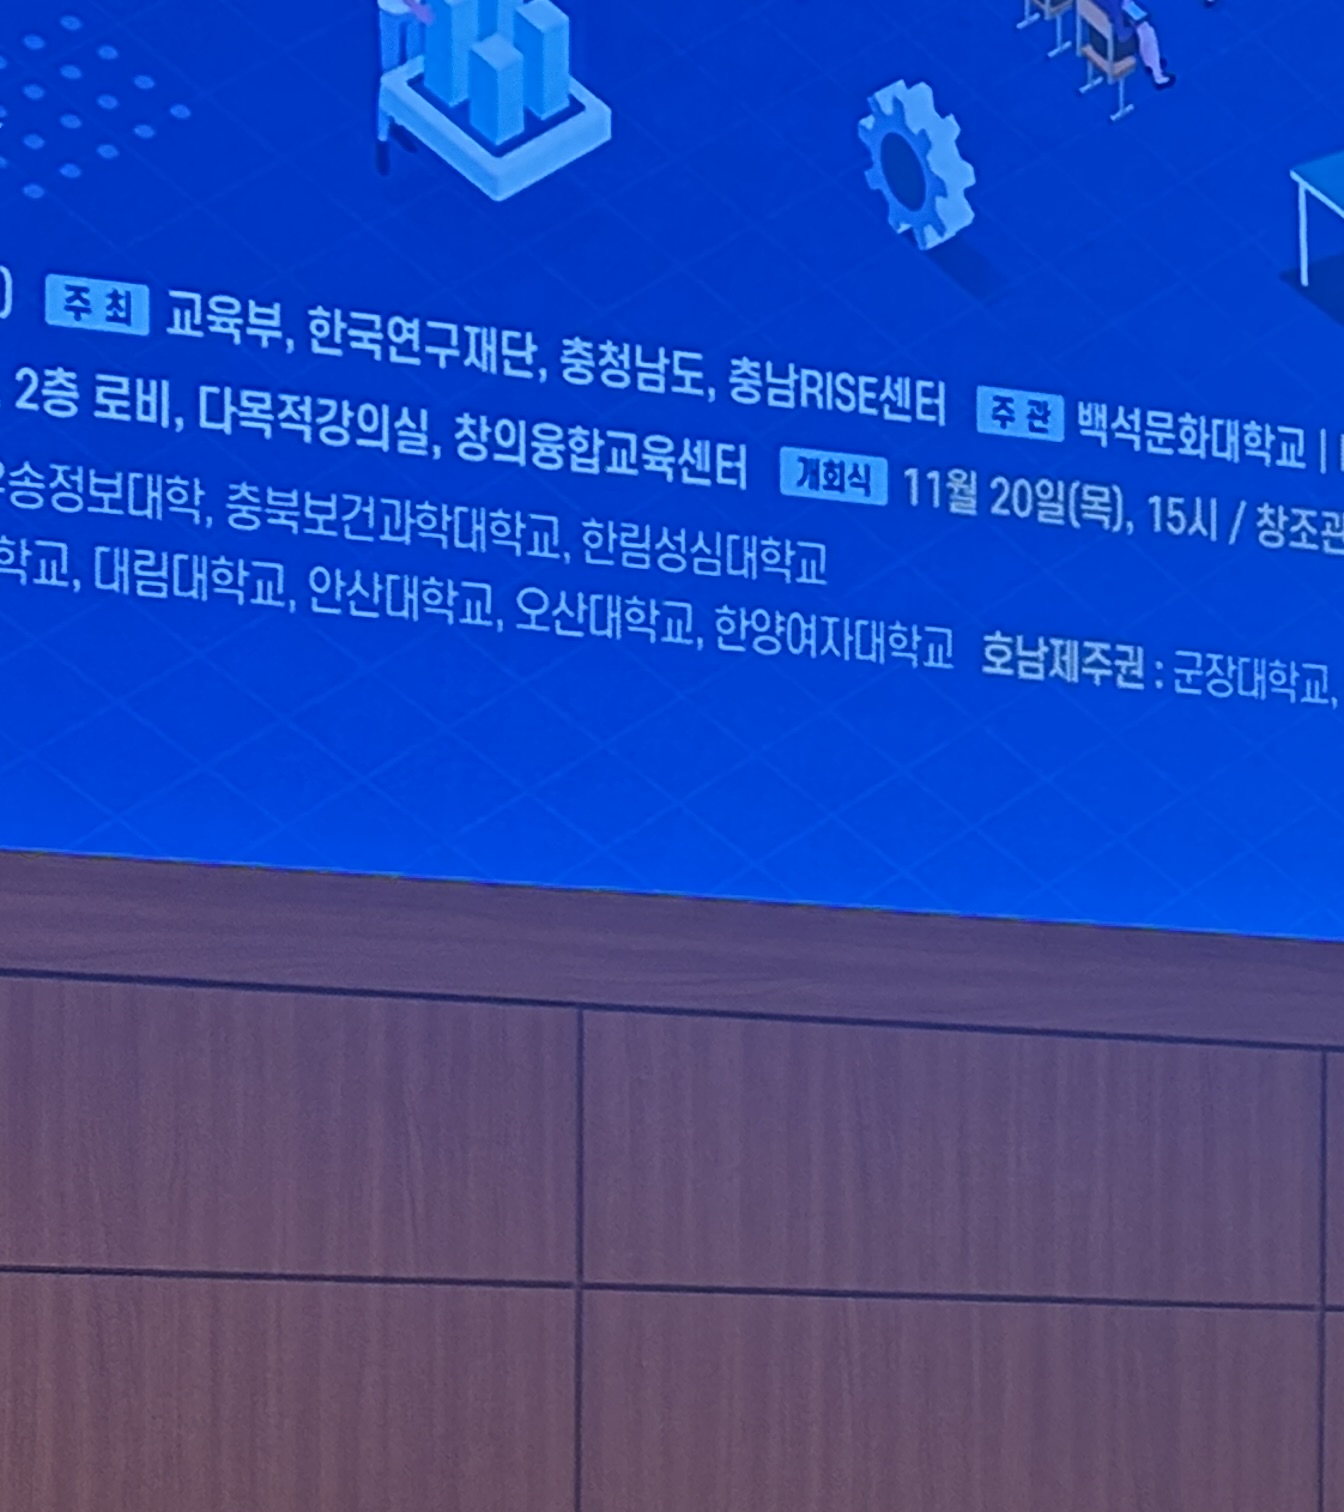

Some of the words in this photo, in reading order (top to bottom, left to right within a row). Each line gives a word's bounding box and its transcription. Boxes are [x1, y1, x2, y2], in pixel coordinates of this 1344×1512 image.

[15, 366, 80, 418] 2층
[93, 373, 184, 433] 로비,
[199, 385, 441, 460] 다목적강의실,
[454, 412, 747, 491] 창의융합교육센터
[904, 467, 977, 516] 11월
[990, 476, 1134, 535] 20일(목),
[1148, 495, 1217, 542] 15시
[166, 290, 294, 354] 교육부,
[307, 305, 547, 383] 한국연구재단,
[560, 336, 716, 403] 충청남도,
[729, 356, 946, 427] 충남RISE센터
[1078, 401, 1307, 469] 백석문화대학교
[0, 461, 213, 528] 송정보대학,
[226, 481, 571, 564] 충북보건과학대학교,
[581, 518, 827, 585] 한림성심대학교
[94, 545, 296, 613] 대림대학교,
[309, 565, 504, 632] 안산대학교,
[516, 586, 704, 651] 오산대학교,
[715, 604, 954, 669] 한양여자대학교
[982, 630, 1145, 690] 호남제주권
[1173, 650, 1338, 709] 군장대학교,
